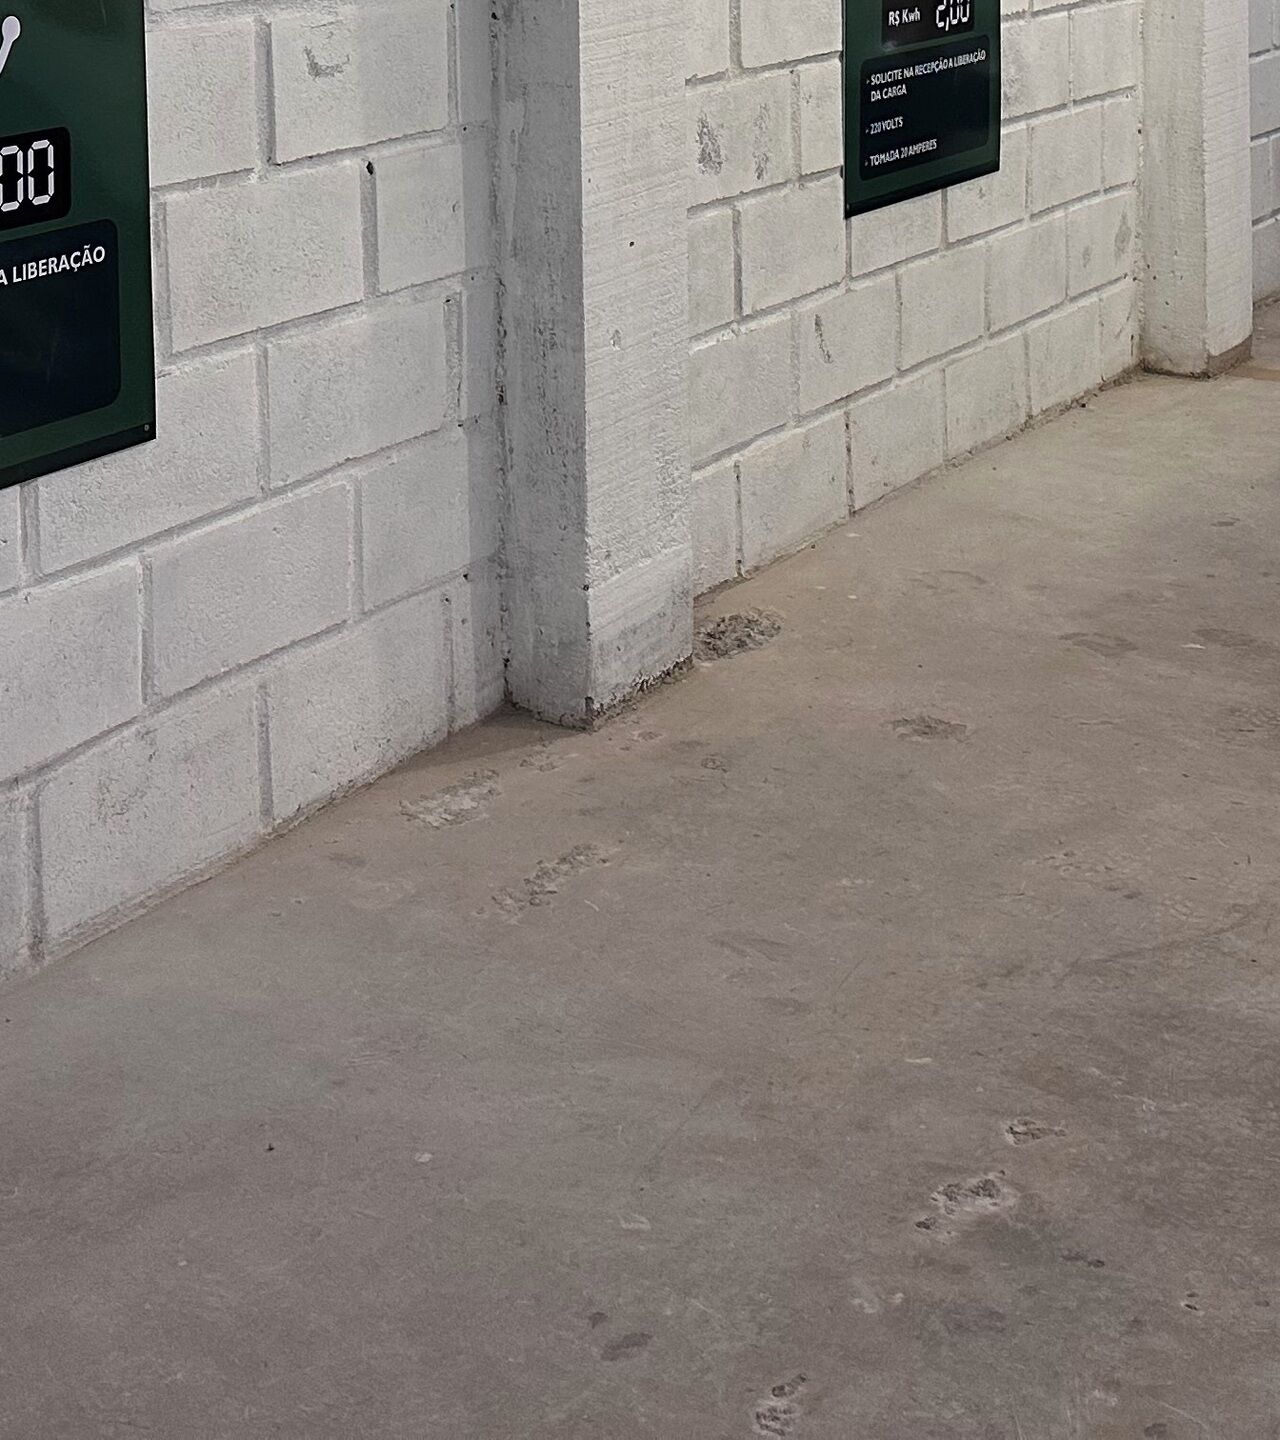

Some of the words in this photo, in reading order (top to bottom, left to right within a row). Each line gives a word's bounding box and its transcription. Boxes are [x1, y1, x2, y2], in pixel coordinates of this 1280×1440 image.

[888, 11, 900, 27] R$
[902, 7, 921, 24] Kwh
[870, 68, 903, 86] SOLICITE
[903, 66, 915, 79] NA
[870, 90, 881, 102] DA
[882, 83, 908, 99] CARGA
[881, 116, 904, 132] VOLTS
[869, 148, 900, 167] TOMADA
[12, 244, 106, 283] LIBERAÇÃO
